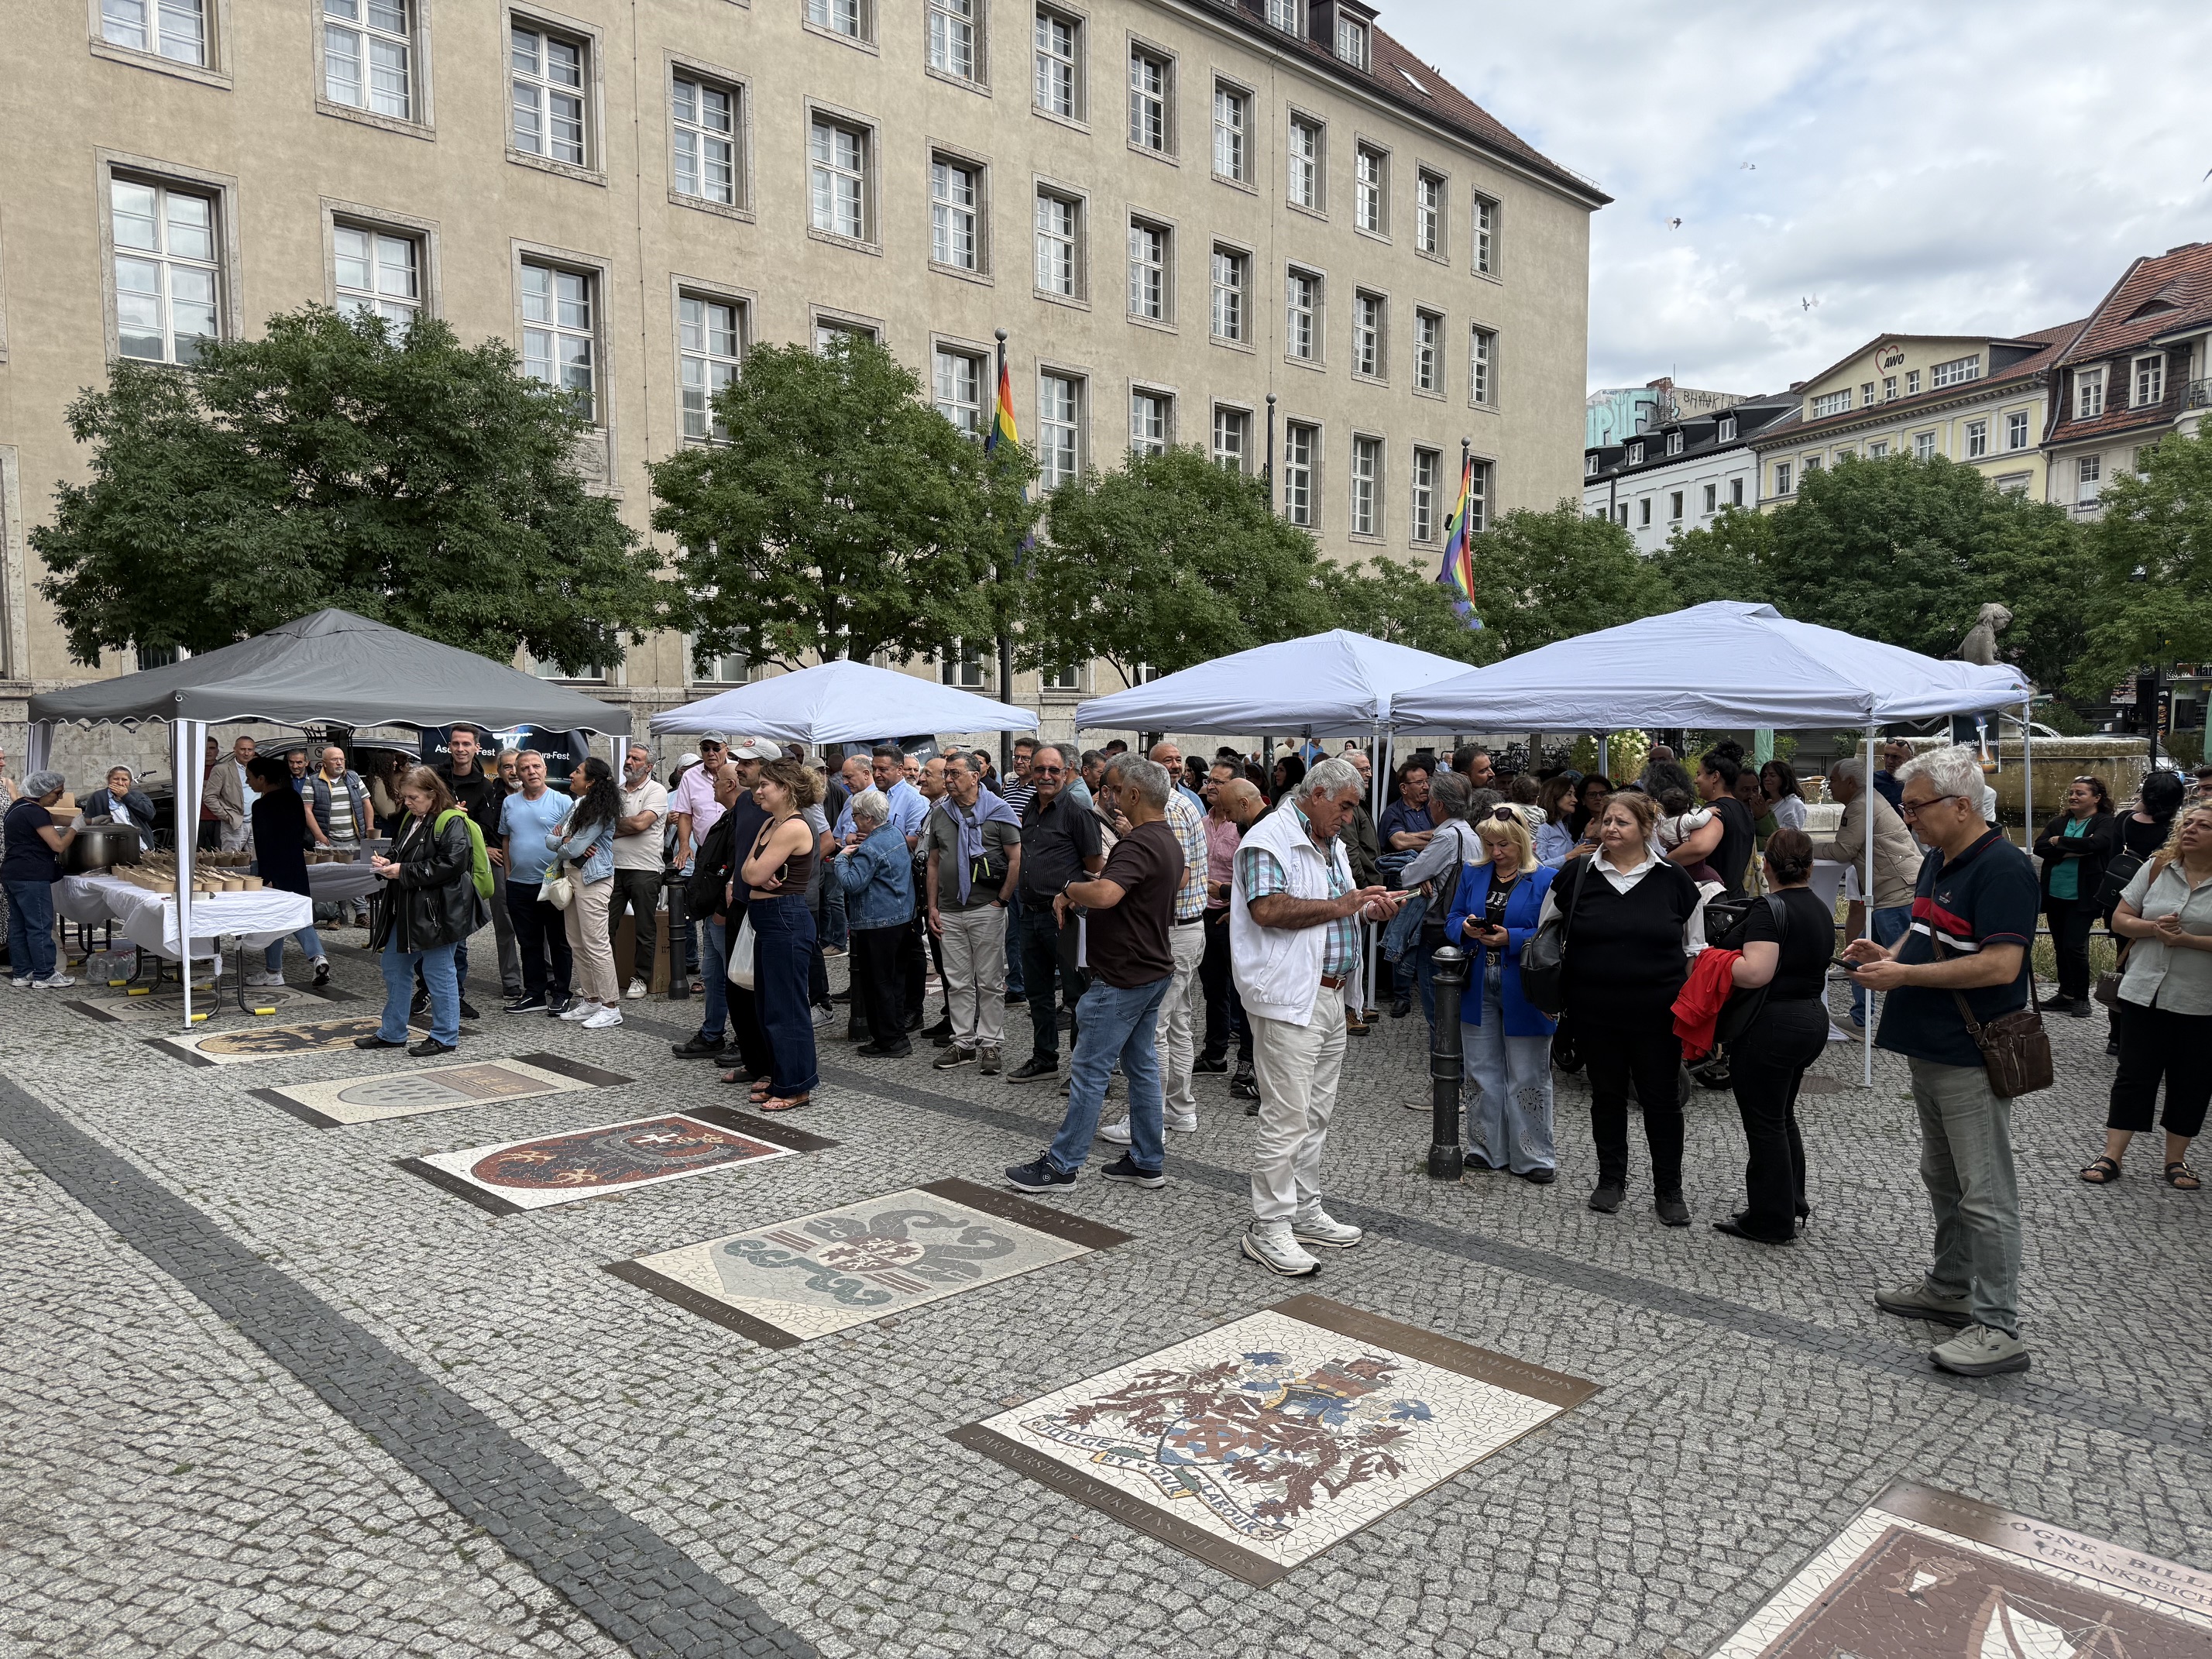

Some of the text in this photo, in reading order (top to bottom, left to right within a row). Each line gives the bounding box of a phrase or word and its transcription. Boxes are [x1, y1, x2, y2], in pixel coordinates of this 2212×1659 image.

[1884, 353, 1905, 369] AWO
[1038, 1424, 1114, 1448] JUDGE
[975, 1434, 1083, 1485] PARTNERSTADT
[1081, 1482, 1177, 1531] NEUKÖLLNS
[1176, 1528, 1220, 1551] SEIT
[1149, 1467, 1187, 1496] OUR
[1200, 1482, 1259, 1534] LABOUR
[1929, 1497, 2098, 1554] BOULOGNE
[2128, 1557, 2212, 1592] BILL
